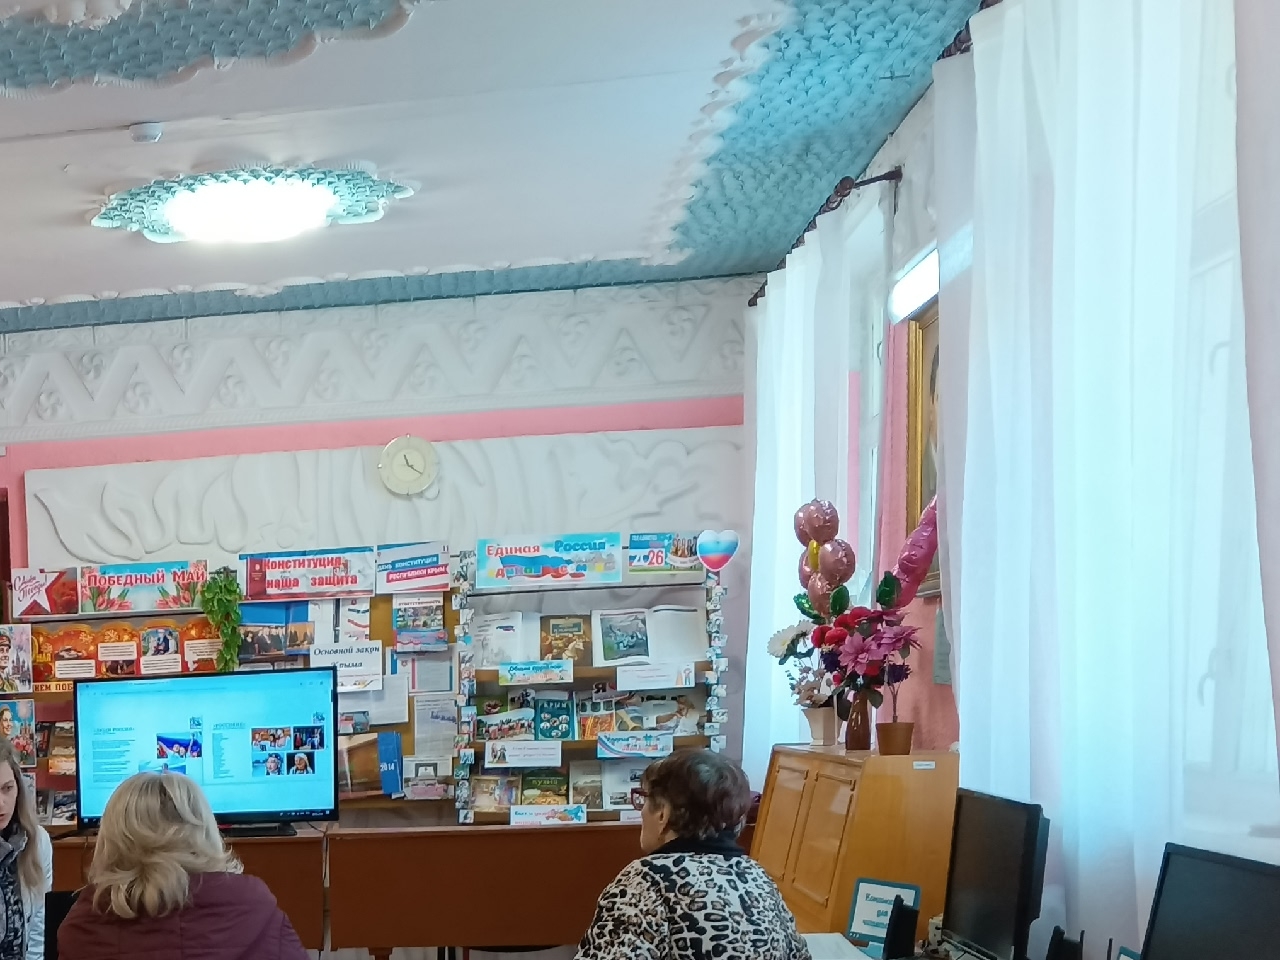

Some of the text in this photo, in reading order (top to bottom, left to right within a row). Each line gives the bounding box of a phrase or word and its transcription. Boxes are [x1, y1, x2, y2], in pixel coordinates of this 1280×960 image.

[486, 544, 540, 557] Единая
[554, 539, 606, 553] Россия
[266, 574, 358, 589] наша защита
[313, 645, 380, 656] Основной закон
